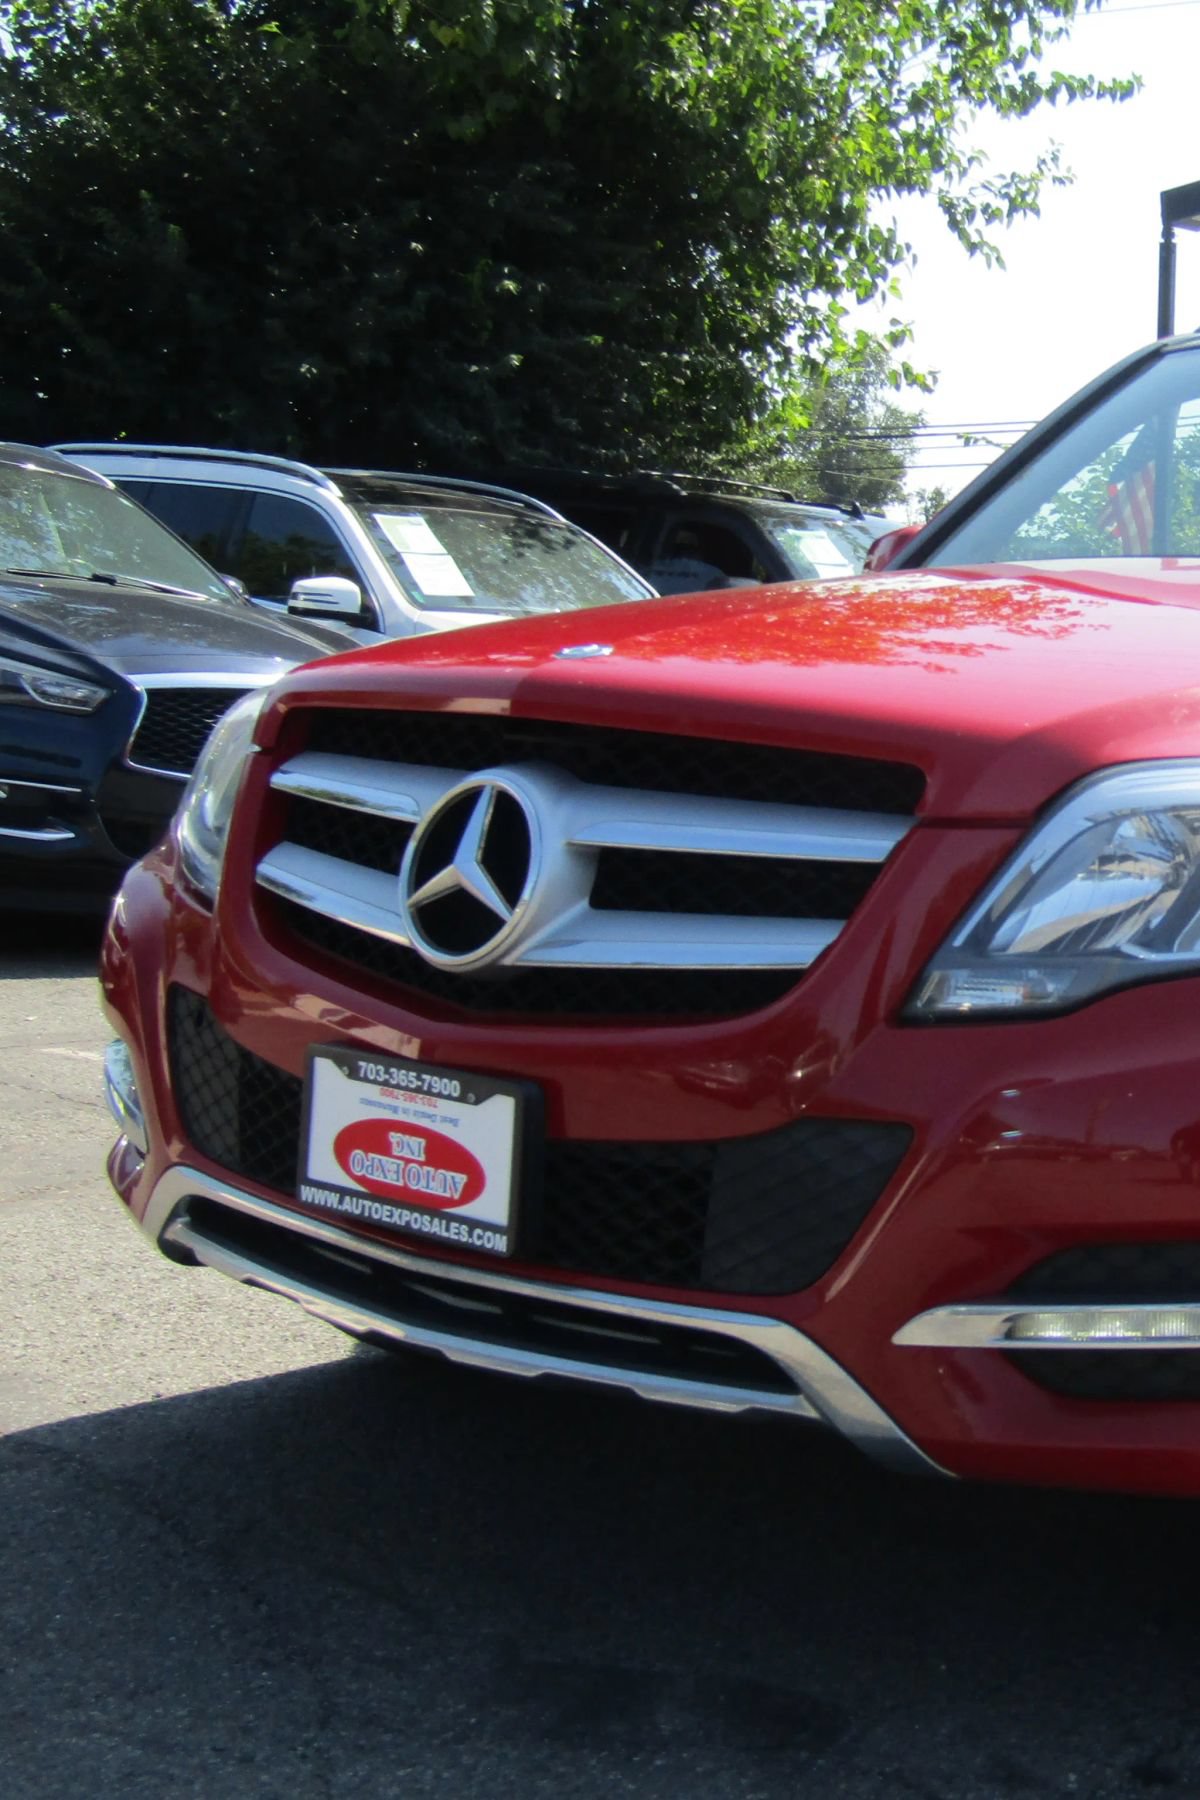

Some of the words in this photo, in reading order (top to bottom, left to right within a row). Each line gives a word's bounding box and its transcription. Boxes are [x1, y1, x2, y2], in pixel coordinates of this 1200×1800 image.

[358, 1061, 461, 1097] 703-365-7900
[388, 1131, 426, 1161] INC.
[350, 1149, 404, 1186] EXPO
[405, 1163, 467, 1199] AUTO
[301, 1185, 508, 1252] WWW.AUTOEXPOSALES.COM
